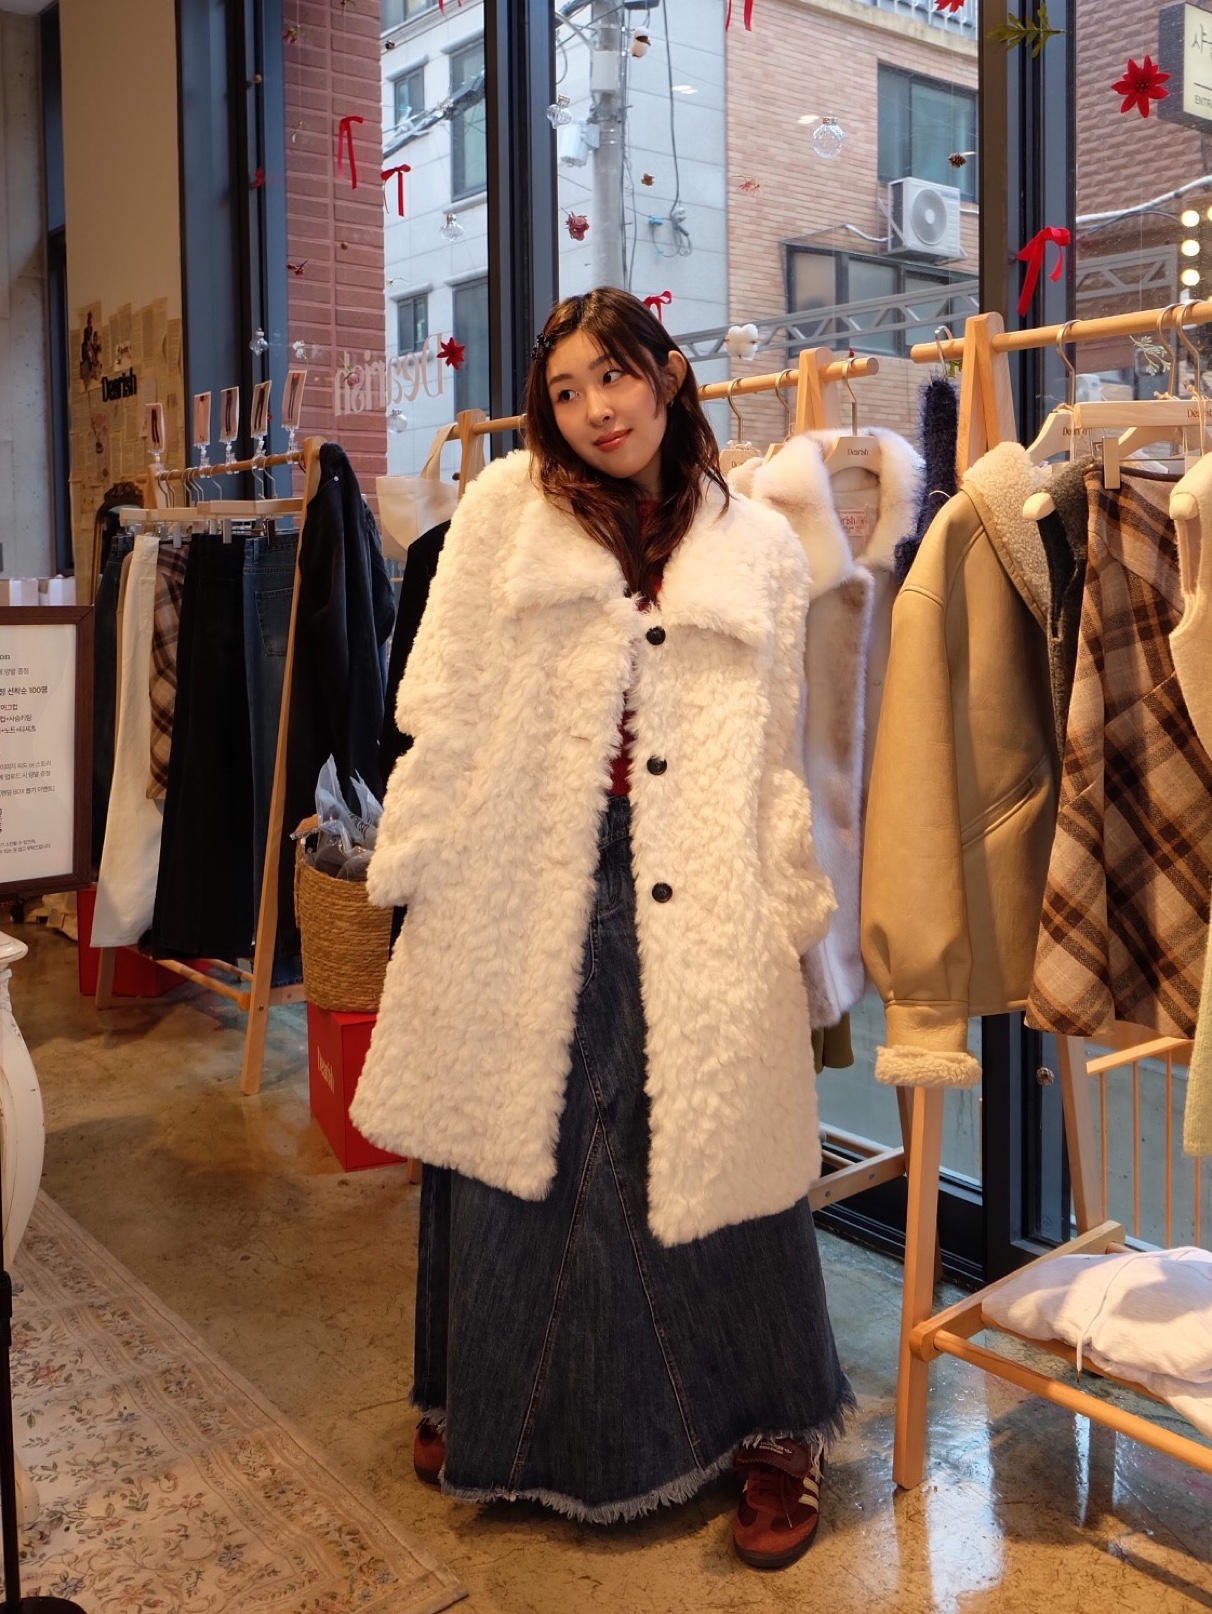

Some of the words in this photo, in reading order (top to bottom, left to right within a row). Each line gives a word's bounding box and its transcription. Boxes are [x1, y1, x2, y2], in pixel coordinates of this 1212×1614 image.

[101, 366, 137, 402] Dearish
[1187, 409, 1212, 418] Deash
[841, 514, 856, 526] rish
